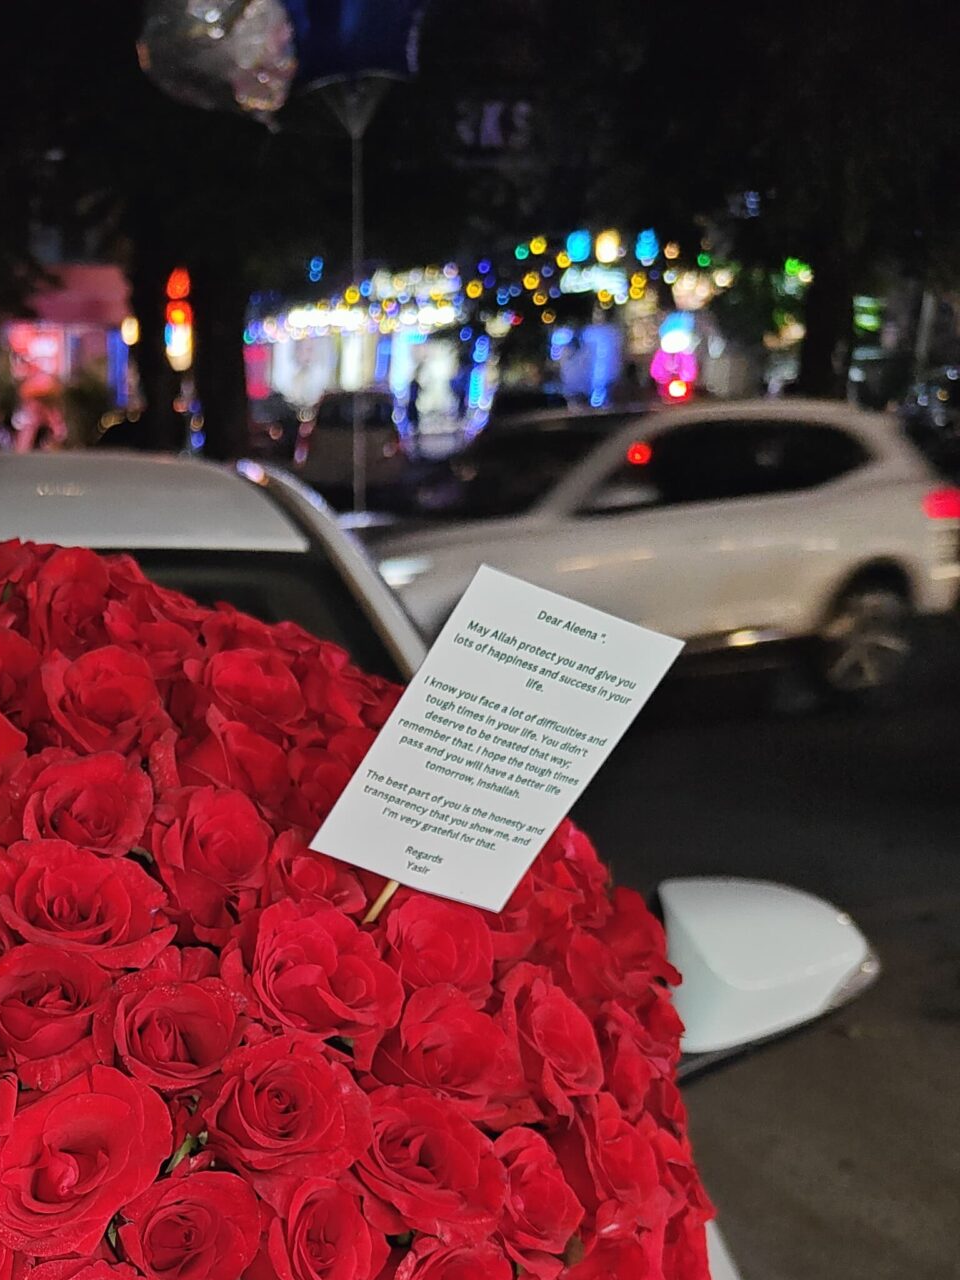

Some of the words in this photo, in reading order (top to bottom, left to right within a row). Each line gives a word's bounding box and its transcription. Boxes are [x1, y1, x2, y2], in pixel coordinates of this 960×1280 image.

[467, 620, 491, 637] May
[490, 630, 517, 646] Allah
[516, 642, 556, 661] protect
[554, 656, 576, 668] you
[576, 664, 597, 675] and
[595, 671, 617, 682] give
[615, 678, 636, 689] you
[537, 610, 563, 626] Dear
[562, 621, 597, 640] Aleena
[454, 633, 474, 647] lots
[475, 644, 489, 652] of
[487, 646, 538, 672] happiness
[539, 668, 560, 679] and
[559, 675, 597, 693] success
[597, 687, 607, 697] in
[606, 692, 632, 704] your
[526, 678, 543, 692] life.
[425, 711, 465, 731] deserve
[466, 726, 477, 735] to
[478, 730, 491, 740] be
[493, 736, 529, 753] treated
[529, 748, 549, 760] that
[426, 694, 455, 711] tough
[457, 706, 485, 721] times
[485, 716, 496, 726] in
[495, 721, 520, 733] your
[520, 728, 537, 741] life.
[541, 735, 559, 747] You
[560, 742, 588, 757] didn't
[430, 677, 458, 694] know
[456, 690, 478, 702] you
[479, 696, 500, 710] face
[509, 707, 524, 719] lot
[536, 717, 587, 740] difficulties
[587, 736, 607, 746] and
[398, 719, 451, 742] remember
[452, 737, 473, 751] that.
[481, 747, 506, 762] hope
[508, 757, 523, 768] the
[525, 763, 552, 777] tough
[553, 772, 579, 785] times
[399, 736, 423, 749] pass
[424, 745, 445, 756] and
[443, 752, 464, 763] you
[466, 760, 483, 770] will
[483, 764, 507, 778] have
[515, 775, 545, 789] better
[545, 784, 560, 795] life
[426, 761, 474, 785] tomorrow,
[364, 785, 429, 815] transparency
[429, 810, 450, 821] that
[449, 818, 468, 827] you
[469, 823, 494, 834] show
[494, 831, 509, 841] me,
[512, 836, 531, 846] and
[367, 769, 384, 782] The
[386, 777, 408, 791] best
[408, 787, 430, 799] part
[442, 800, 461, 810] you
[462, 804, 471, 813] is
[472, 808, 487, 818] the
[488, 812, 526, 831] honesty
[526, 826, 545, 835] and
[383, 807, 398, 818] I'm
[400, 815, 421, 828] very
[421, 824, 460, 839] grateful
[460, 834, 475, 843] for
[476, 839, 495, 850] that.
[405, 846, 443, 863] Regards
[407, 861, 430, 874] Yasir
